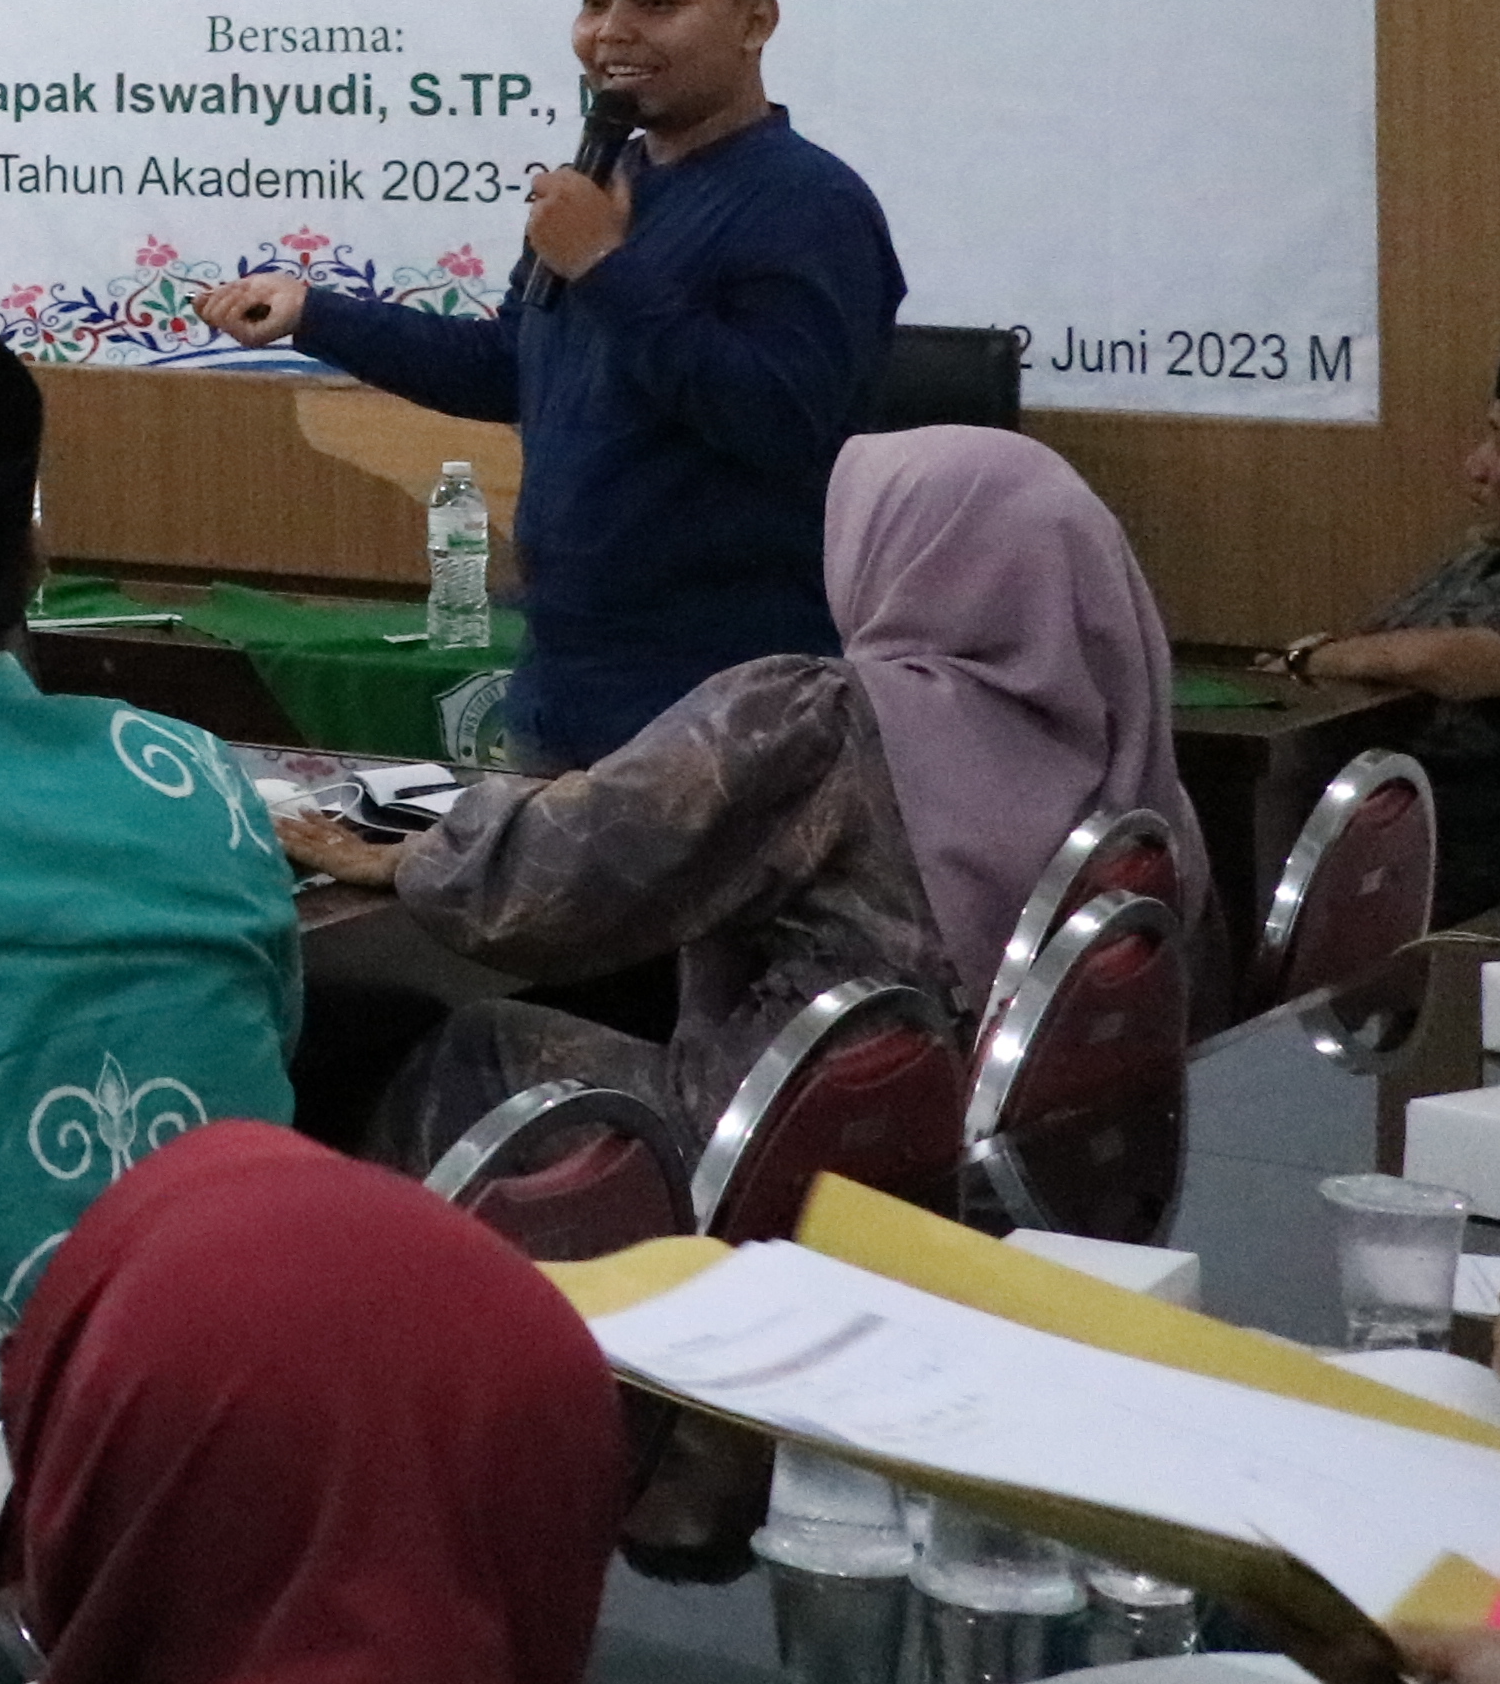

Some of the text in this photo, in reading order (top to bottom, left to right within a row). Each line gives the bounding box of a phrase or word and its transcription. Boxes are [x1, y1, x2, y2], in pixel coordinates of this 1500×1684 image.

[206, 15, 404, 54] Bersama:
[115, 71, 388, 127] Iswahyudi,
[408, 71, 555, 126] S.TP.,
[136, 155, 365, 201] Akademik
[991, 323, 1351, 381] 2 Juni 2023 M
